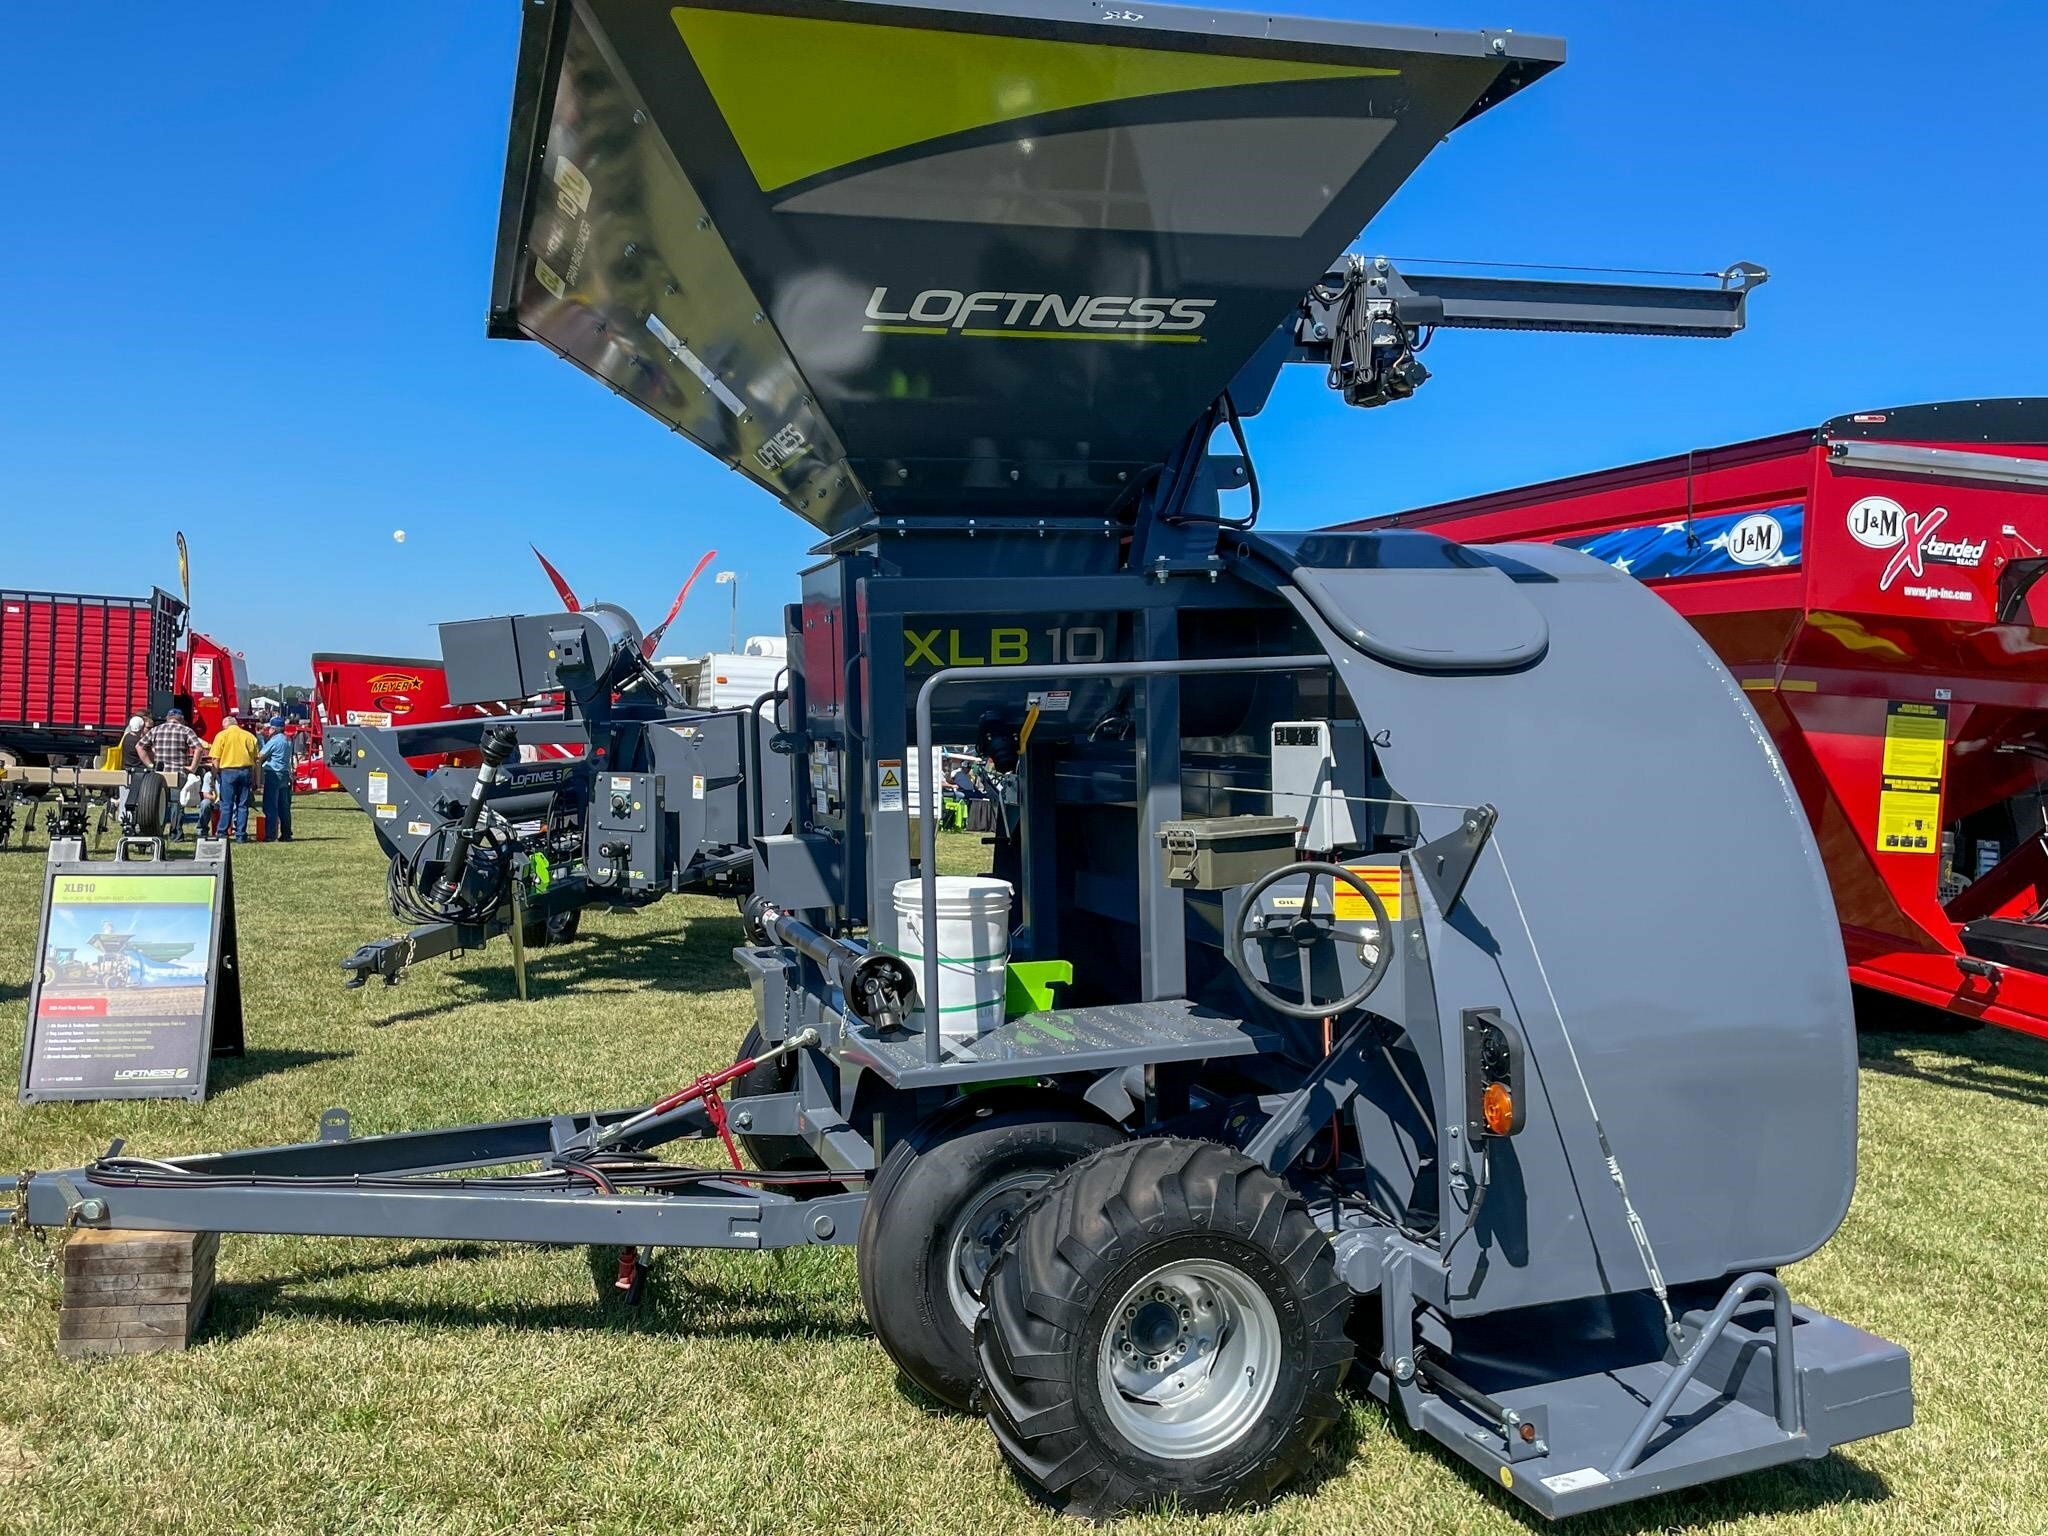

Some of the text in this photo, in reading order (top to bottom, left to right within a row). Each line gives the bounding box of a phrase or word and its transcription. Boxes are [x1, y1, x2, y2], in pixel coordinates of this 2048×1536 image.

[865, 287, 1217, 329] LOFTNESS
[753, 423, 805, 470] LOFTNESS
[1854, 508, 1898, 537] J&M
[1733, 524, 1772, 554] J&M
[1904, 586, 1972, 600] www.jm-inc.com
[904, 627, 1104, 666] XLB 10
[370, 681, 411, 693] MEYER
[63, 883, 95, 893] XLB10
[115, 1069, 176, 1079] LOFTNESS
